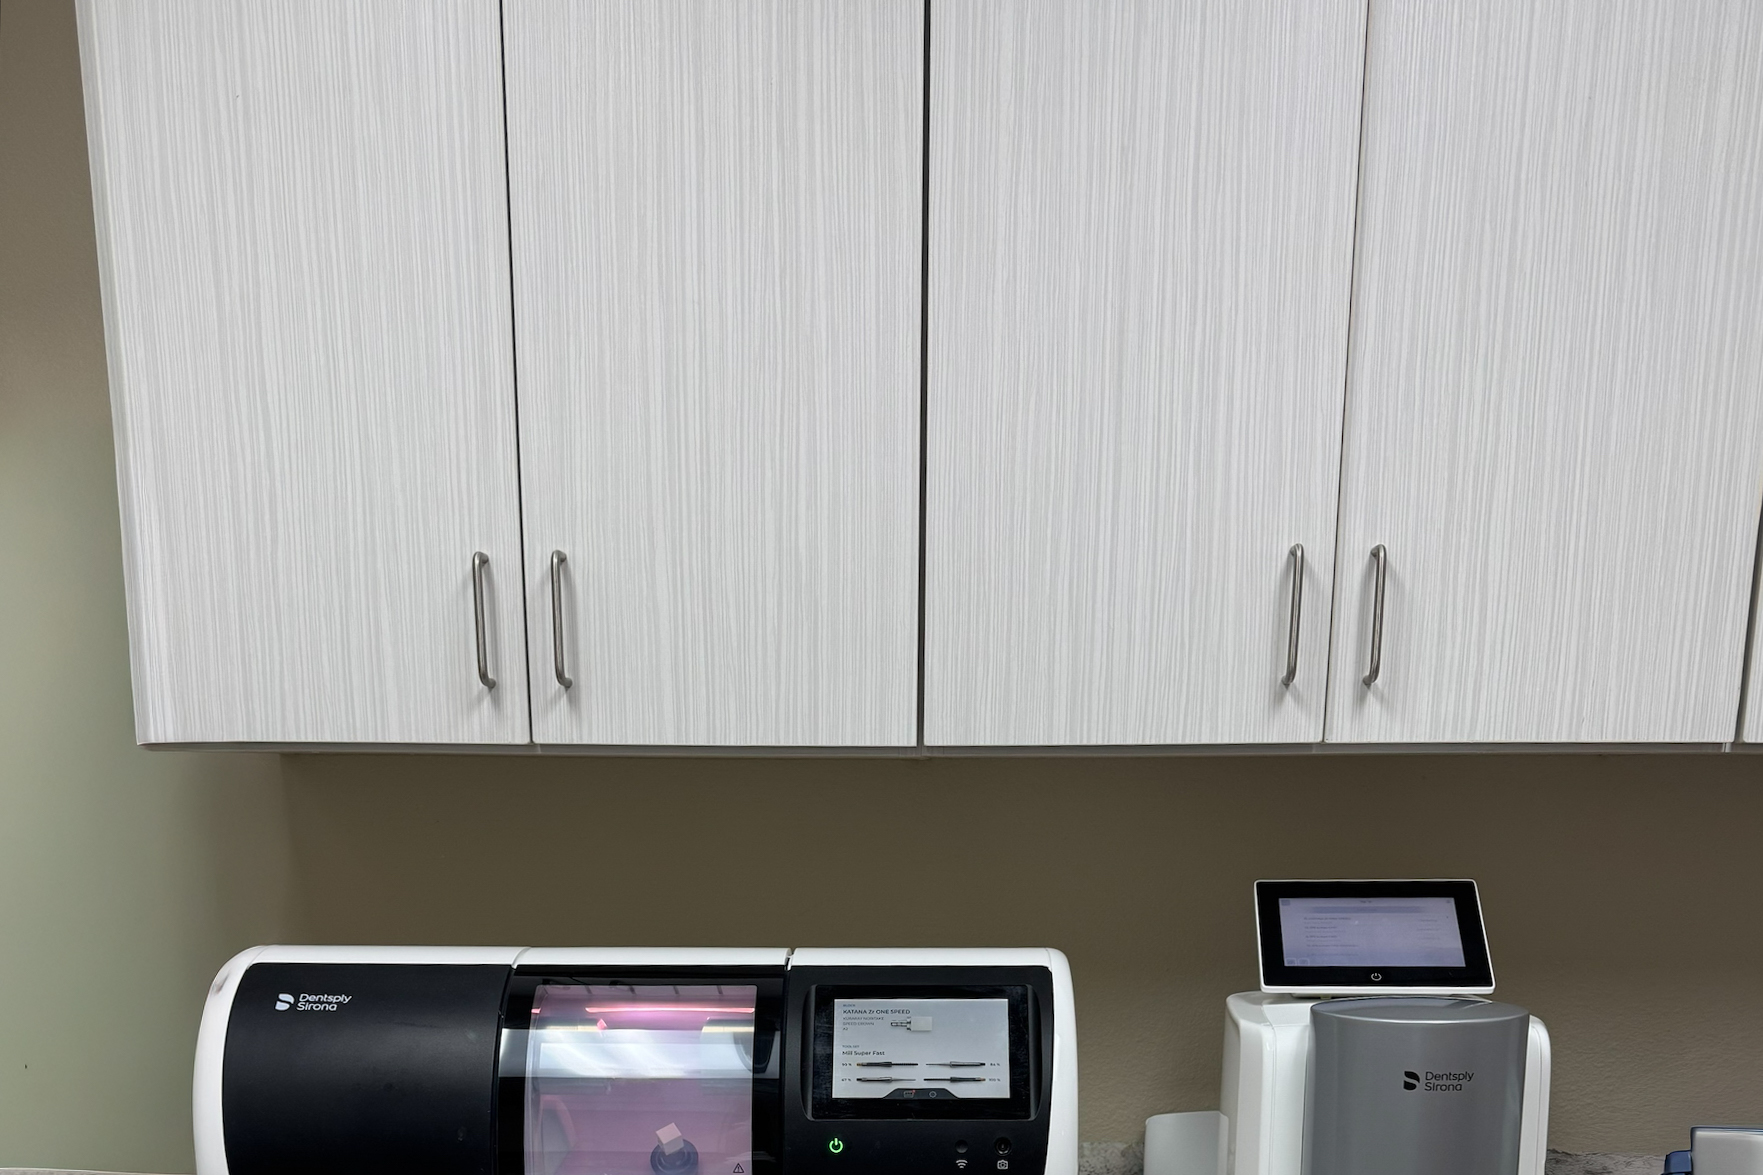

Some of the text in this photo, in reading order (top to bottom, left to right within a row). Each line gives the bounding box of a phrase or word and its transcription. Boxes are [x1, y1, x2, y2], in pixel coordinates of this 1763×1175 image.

[299, 993, 352, 1004] Dentsply
[296, 1002, 337, 1011] Sirona
[1425, 1071, 1475, 1083] Dentsply
[1424, 1082, 1463, 1091] Sirona
